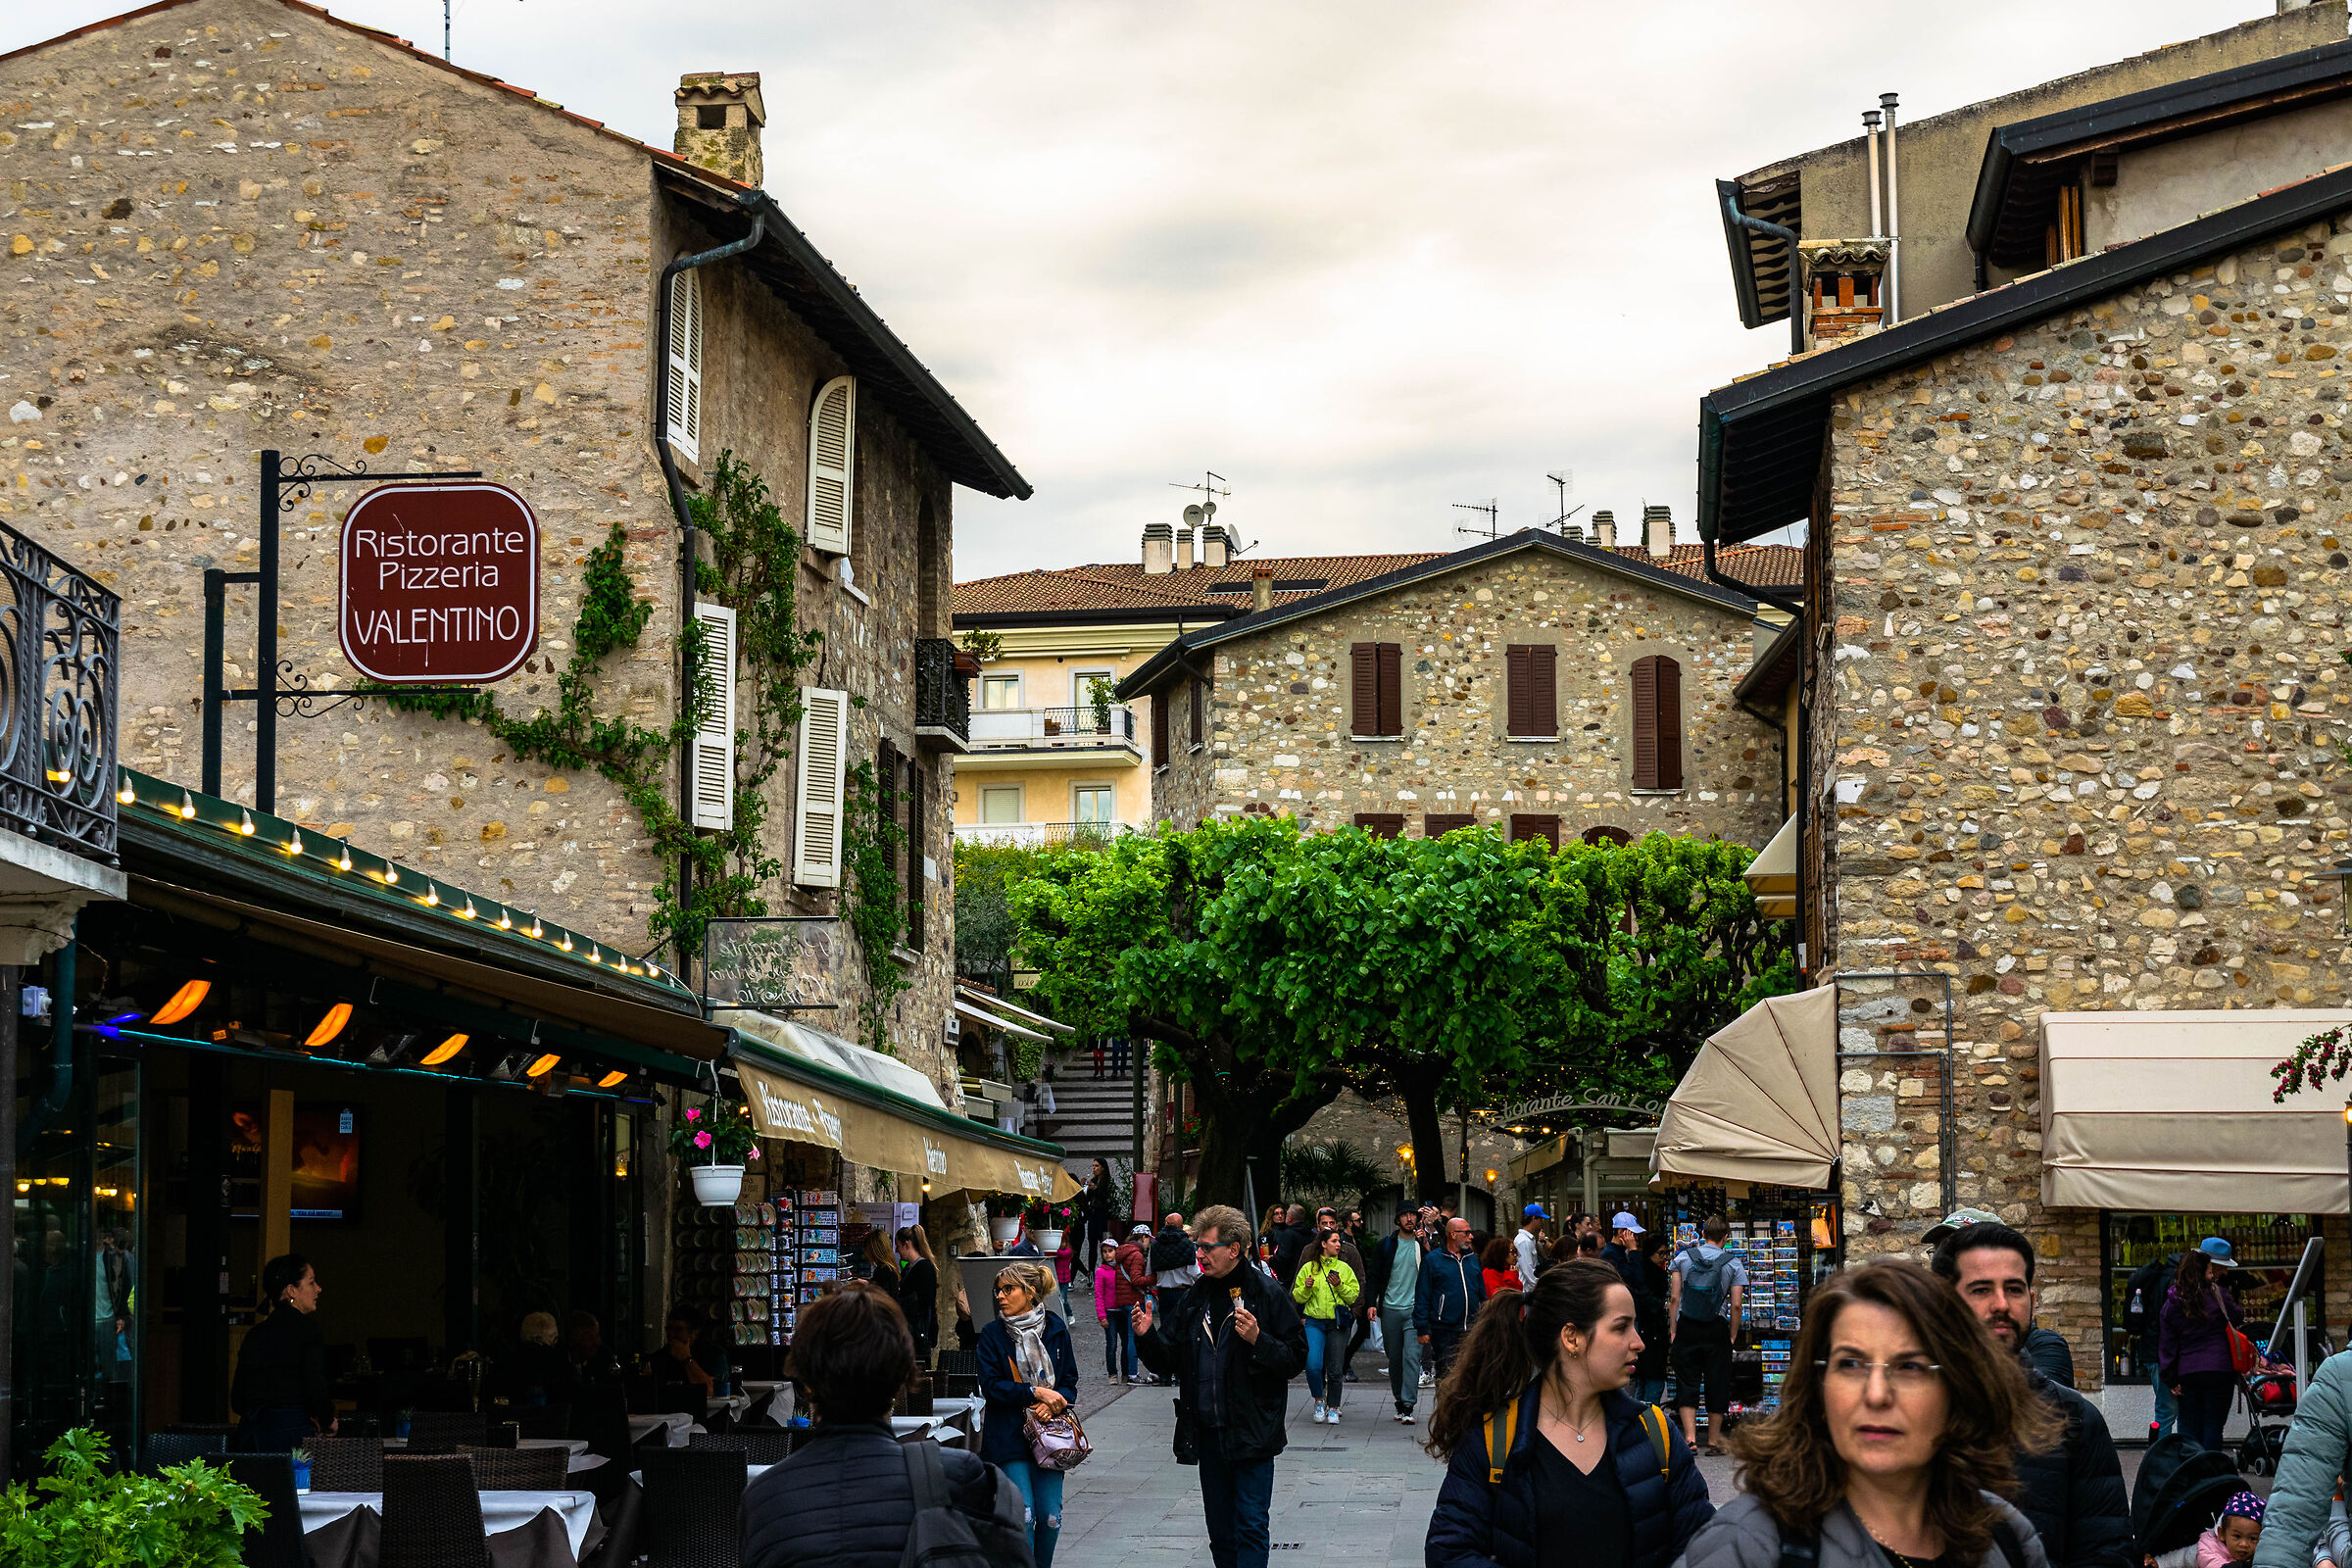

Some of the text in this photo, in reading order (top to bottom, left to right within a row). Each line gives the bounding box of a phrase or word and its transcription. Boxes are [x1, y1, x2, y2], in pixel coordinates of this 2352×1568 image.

[356, 527, 524, 559] Ristorante
[379, 562, 499, 591] Pizzeria
[354, 605, 520, 645] VALENTINO
[1578, 1088, 1621, 1106] San
[1629, 1092, 1669, 1113] Lor
